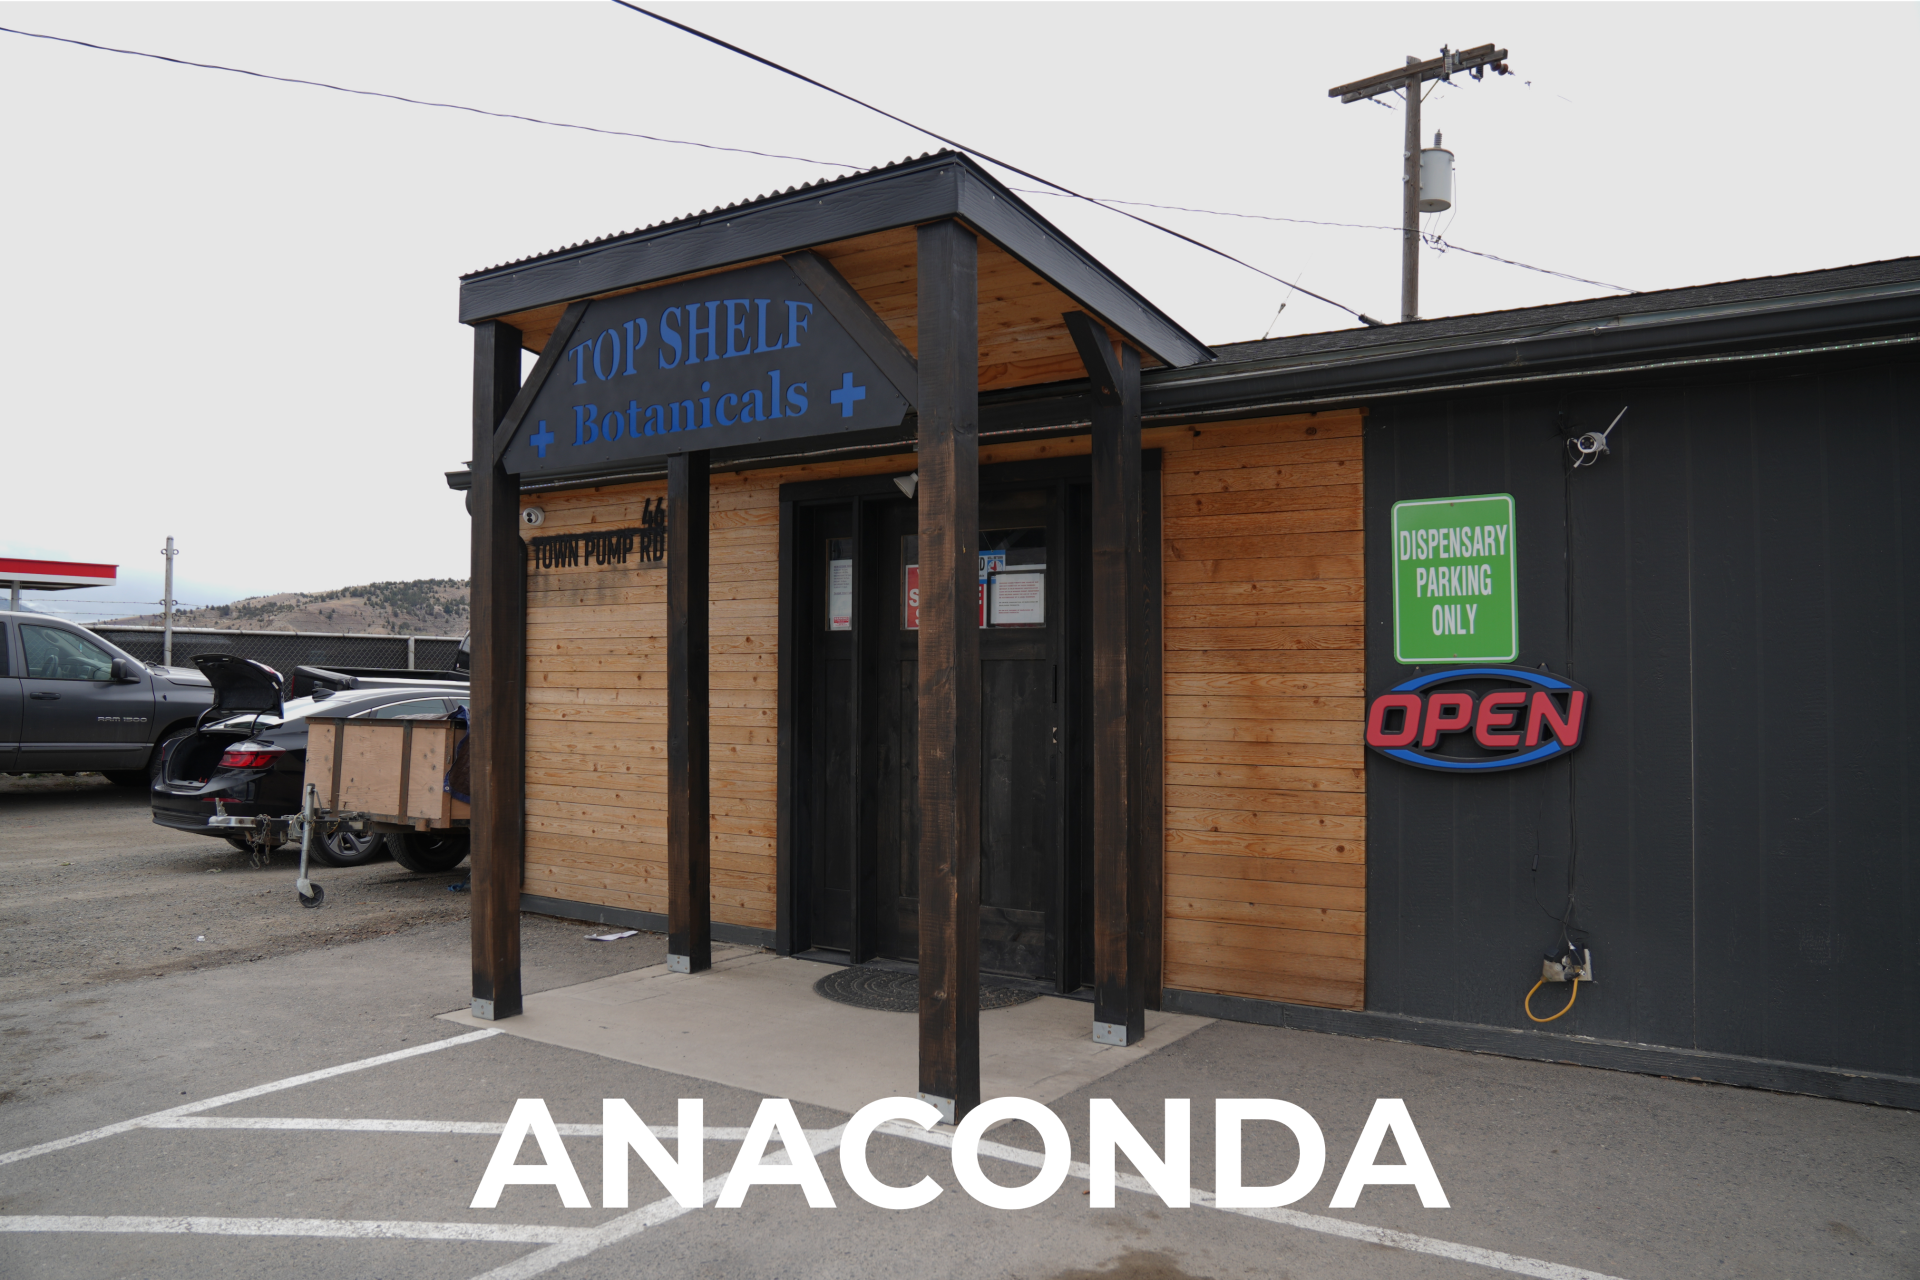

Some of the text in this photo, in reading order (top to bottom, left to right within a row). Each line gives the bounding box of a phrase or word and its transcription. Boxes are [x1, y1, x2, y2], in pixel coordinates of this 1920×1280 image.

[568, 298, 814, 386] TOP SHELF
[572, 369, 809, 447] Botanicals
[641, 497, 665, 530] 46
[533, 529, 665, 570] TOWN PUMP RD
[1400, 525, 1508, 561] DISPENSARY
[1416, 564, 1492, 598] PARKING
[1432, 603, 1478, 636] ONLY
[1366, 690, 1585, 747] OPEN
